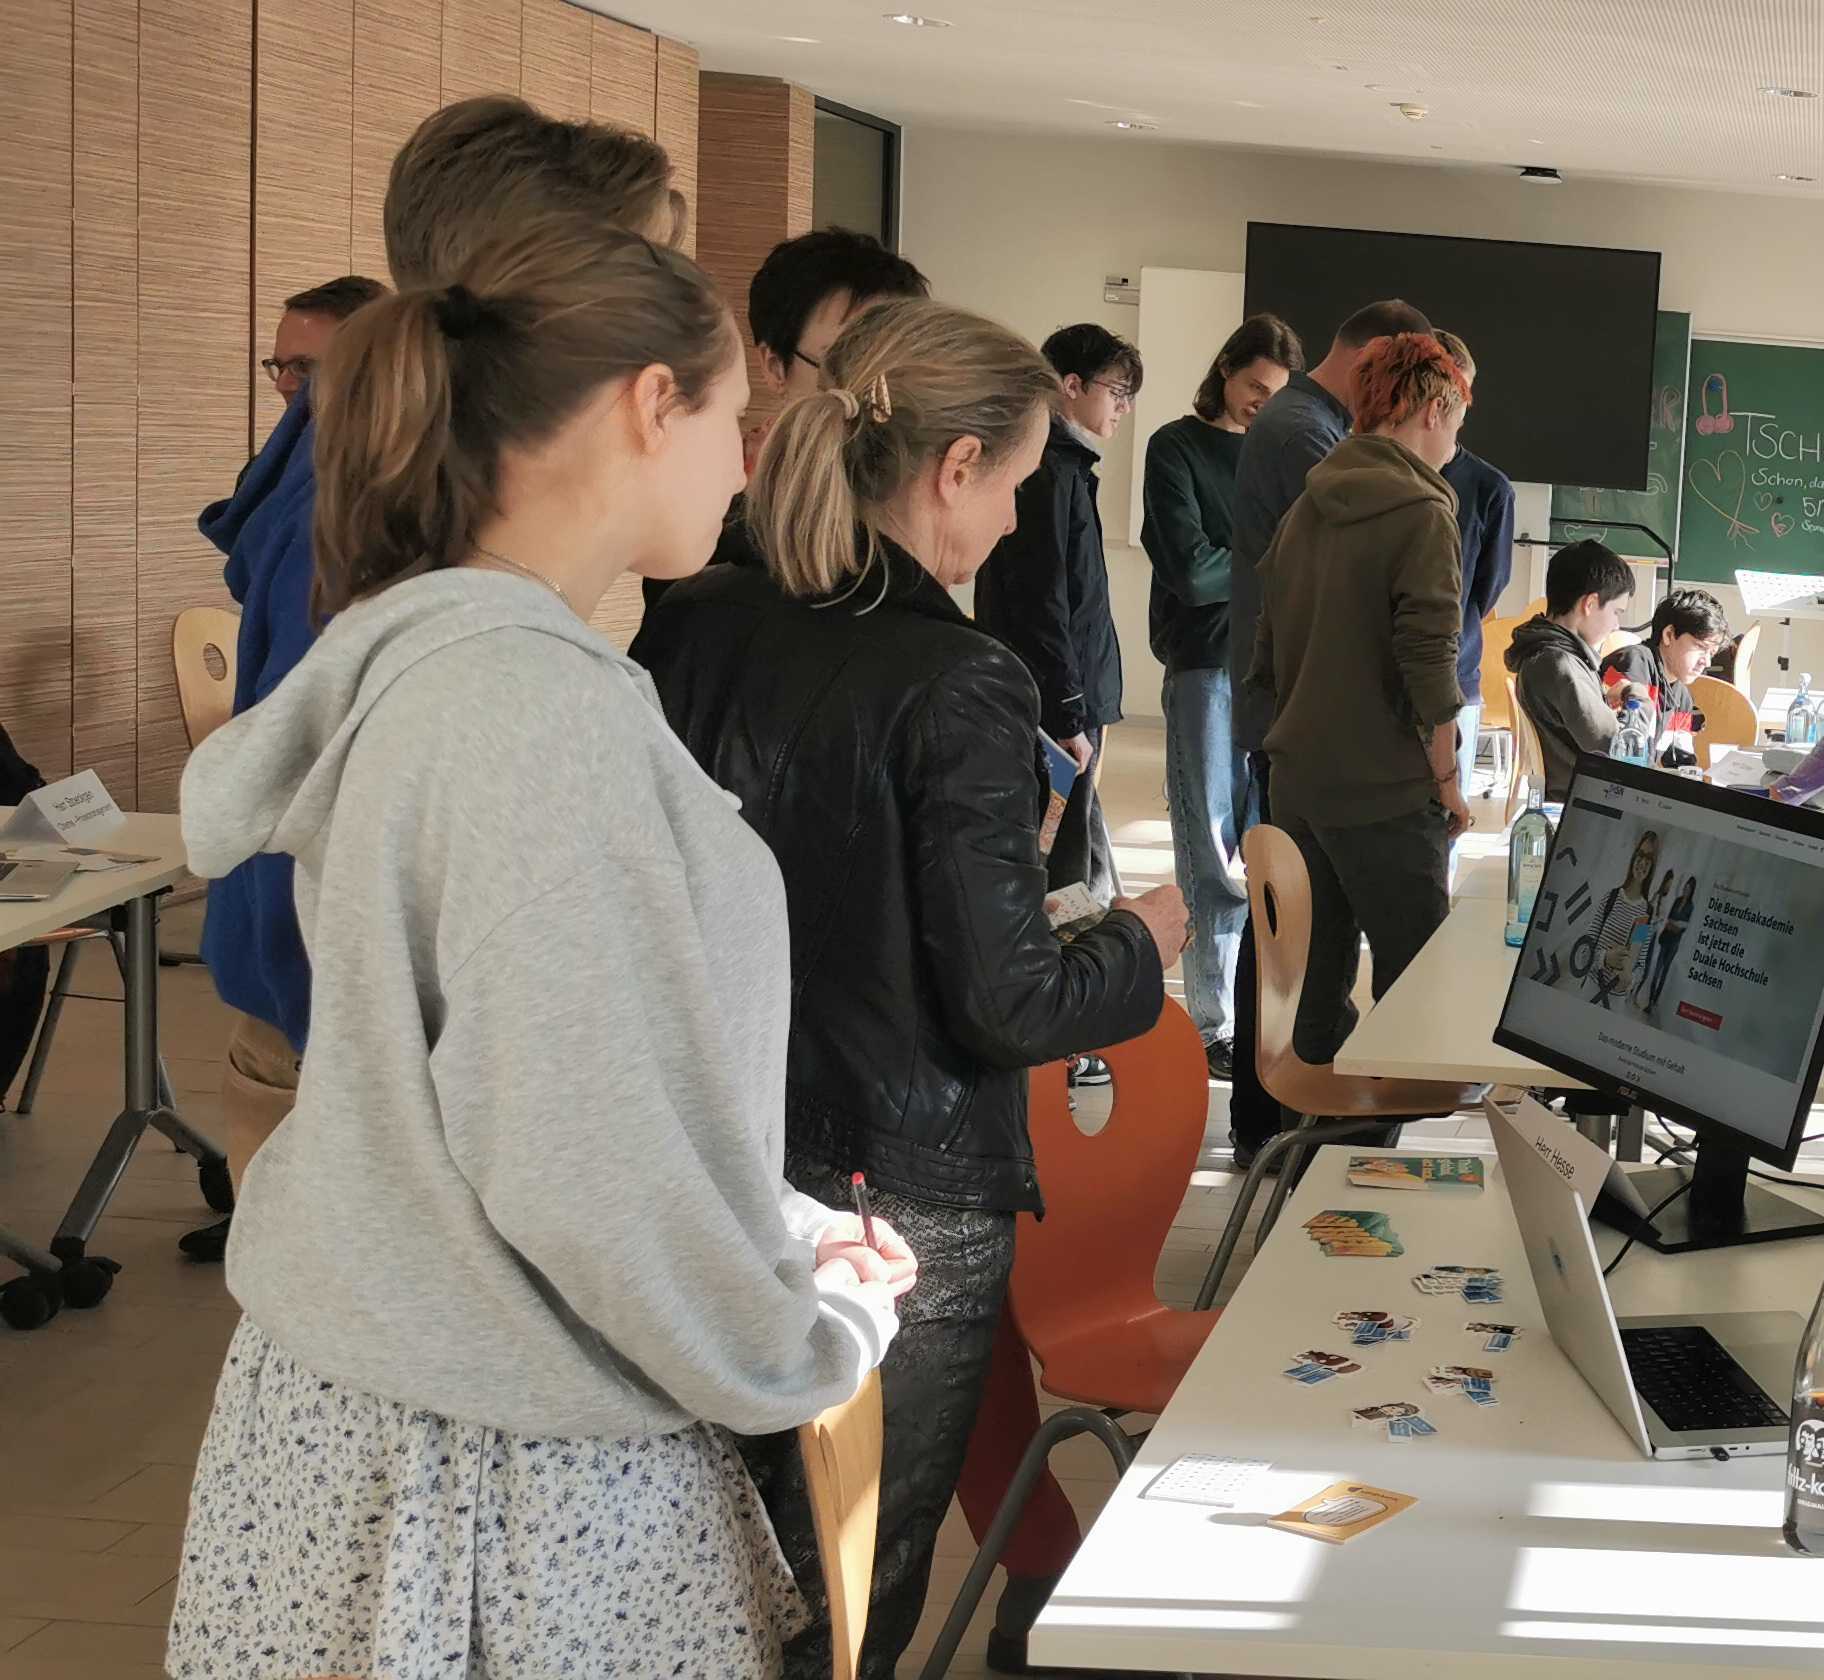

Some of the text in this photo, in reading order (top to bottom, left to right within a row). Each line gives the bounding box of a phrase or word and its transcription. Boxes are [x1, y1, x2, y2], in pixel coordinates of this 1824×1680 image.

[1703, 914, 1739, 938] Sachsen
[1708, 897, 1795, 936] Die Berufsakademie
[1697, 930, 1745, 958] ist jetzt die
[1687, 966, 1724, 990] Sachsen
[1692, 949, 1769, 986] Duale Hochschule
[1535, 1135, 1576, 1180] Herr Hesse
